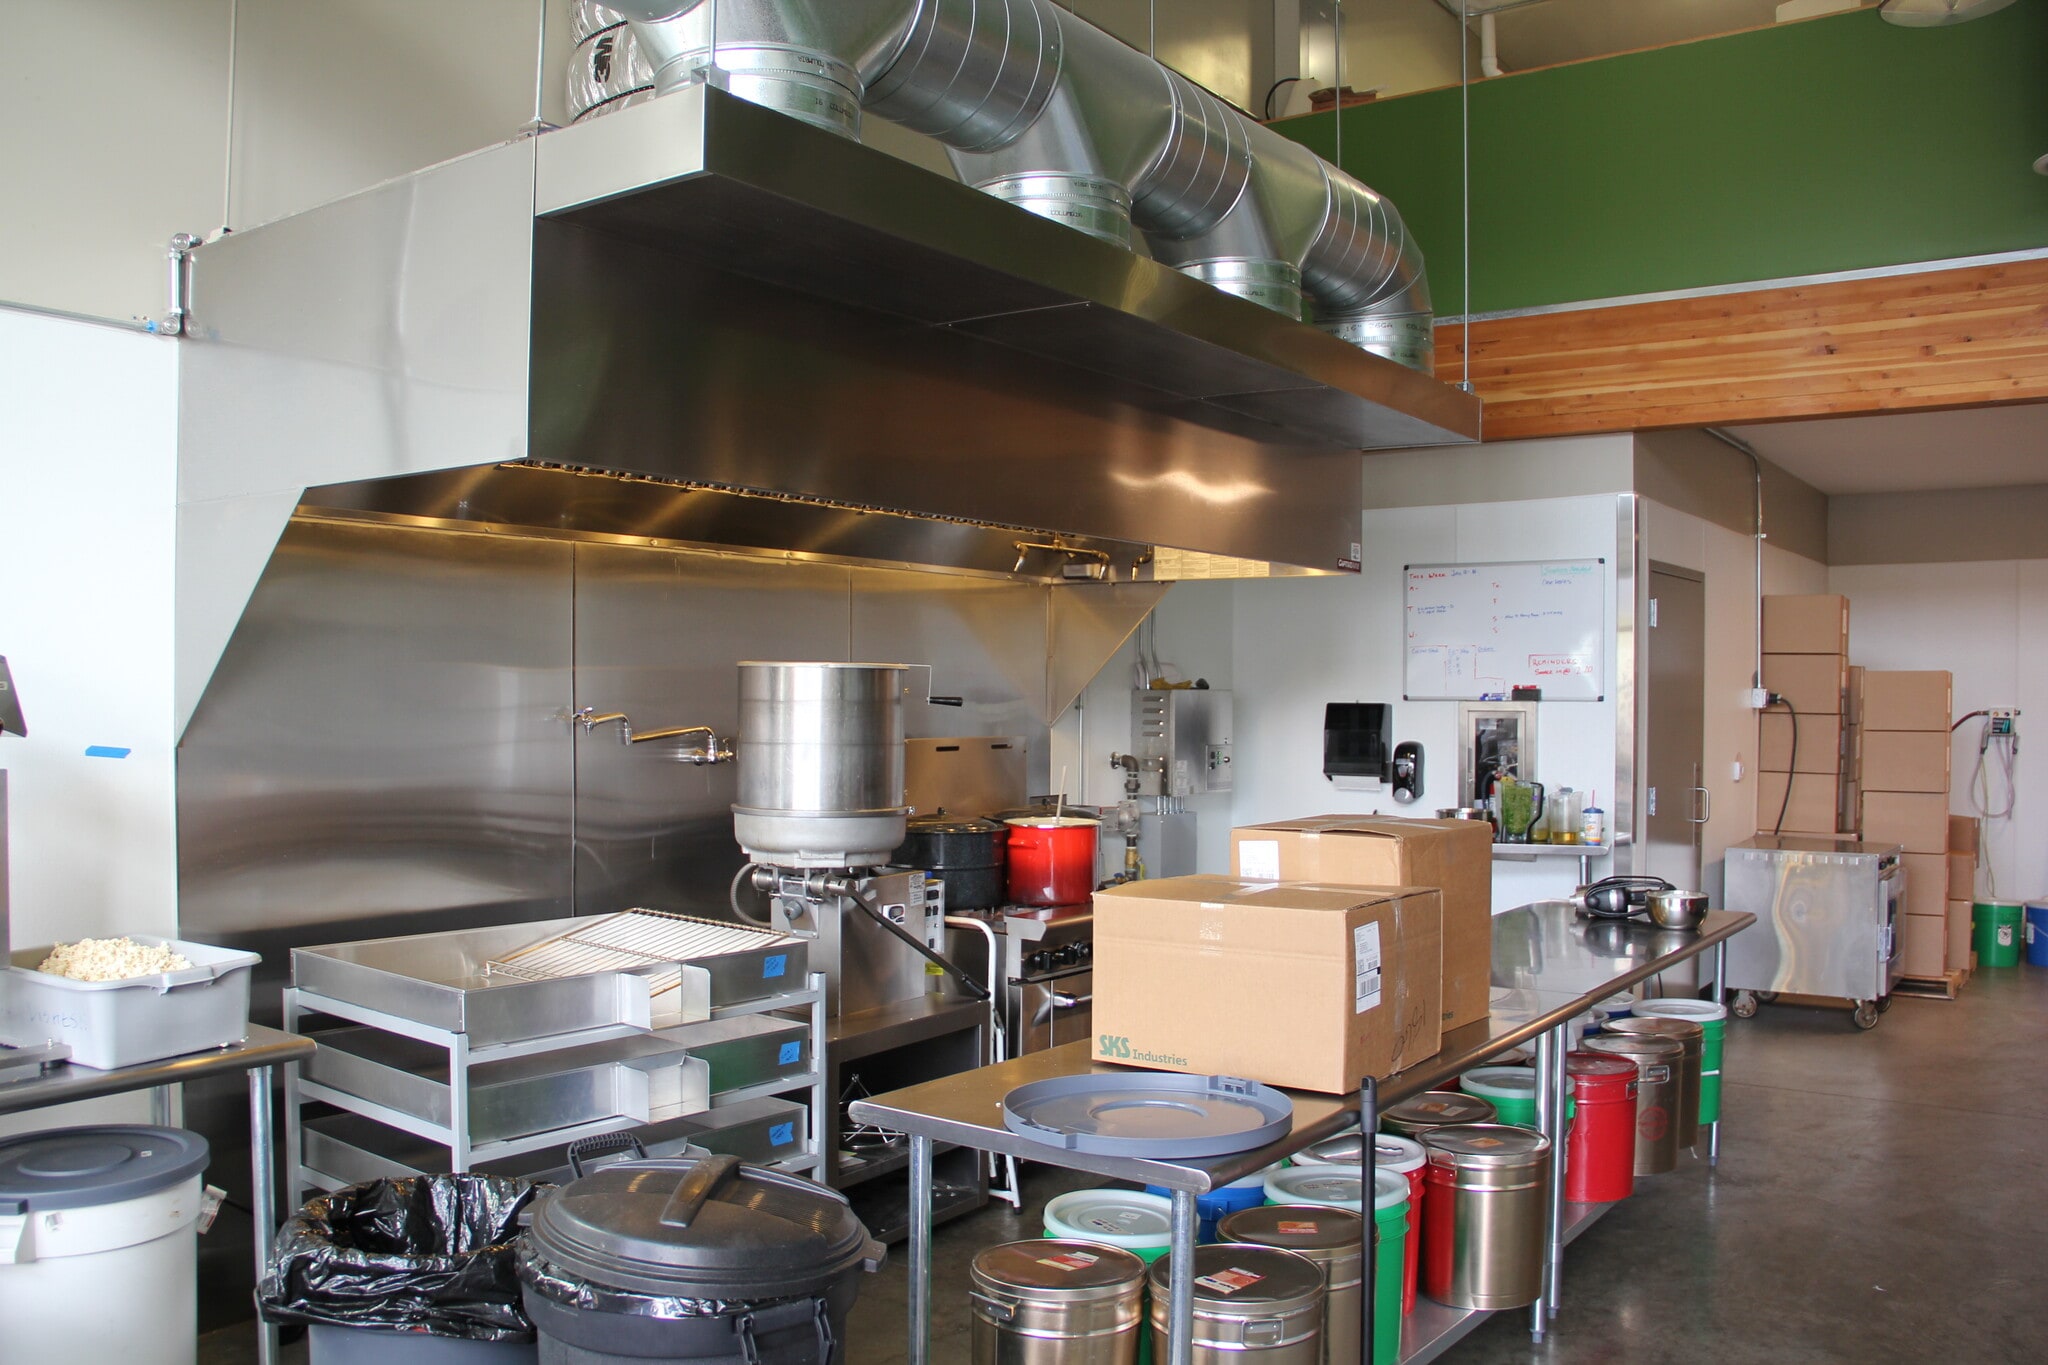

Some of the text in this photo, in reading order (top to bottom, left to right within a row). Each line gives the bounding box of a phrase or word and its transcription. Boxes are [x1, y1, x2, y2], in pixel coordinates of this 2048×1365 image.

[594, 37, 613, 83] 3M
[1099, 1034, 1188, 1066] SKS Industries
